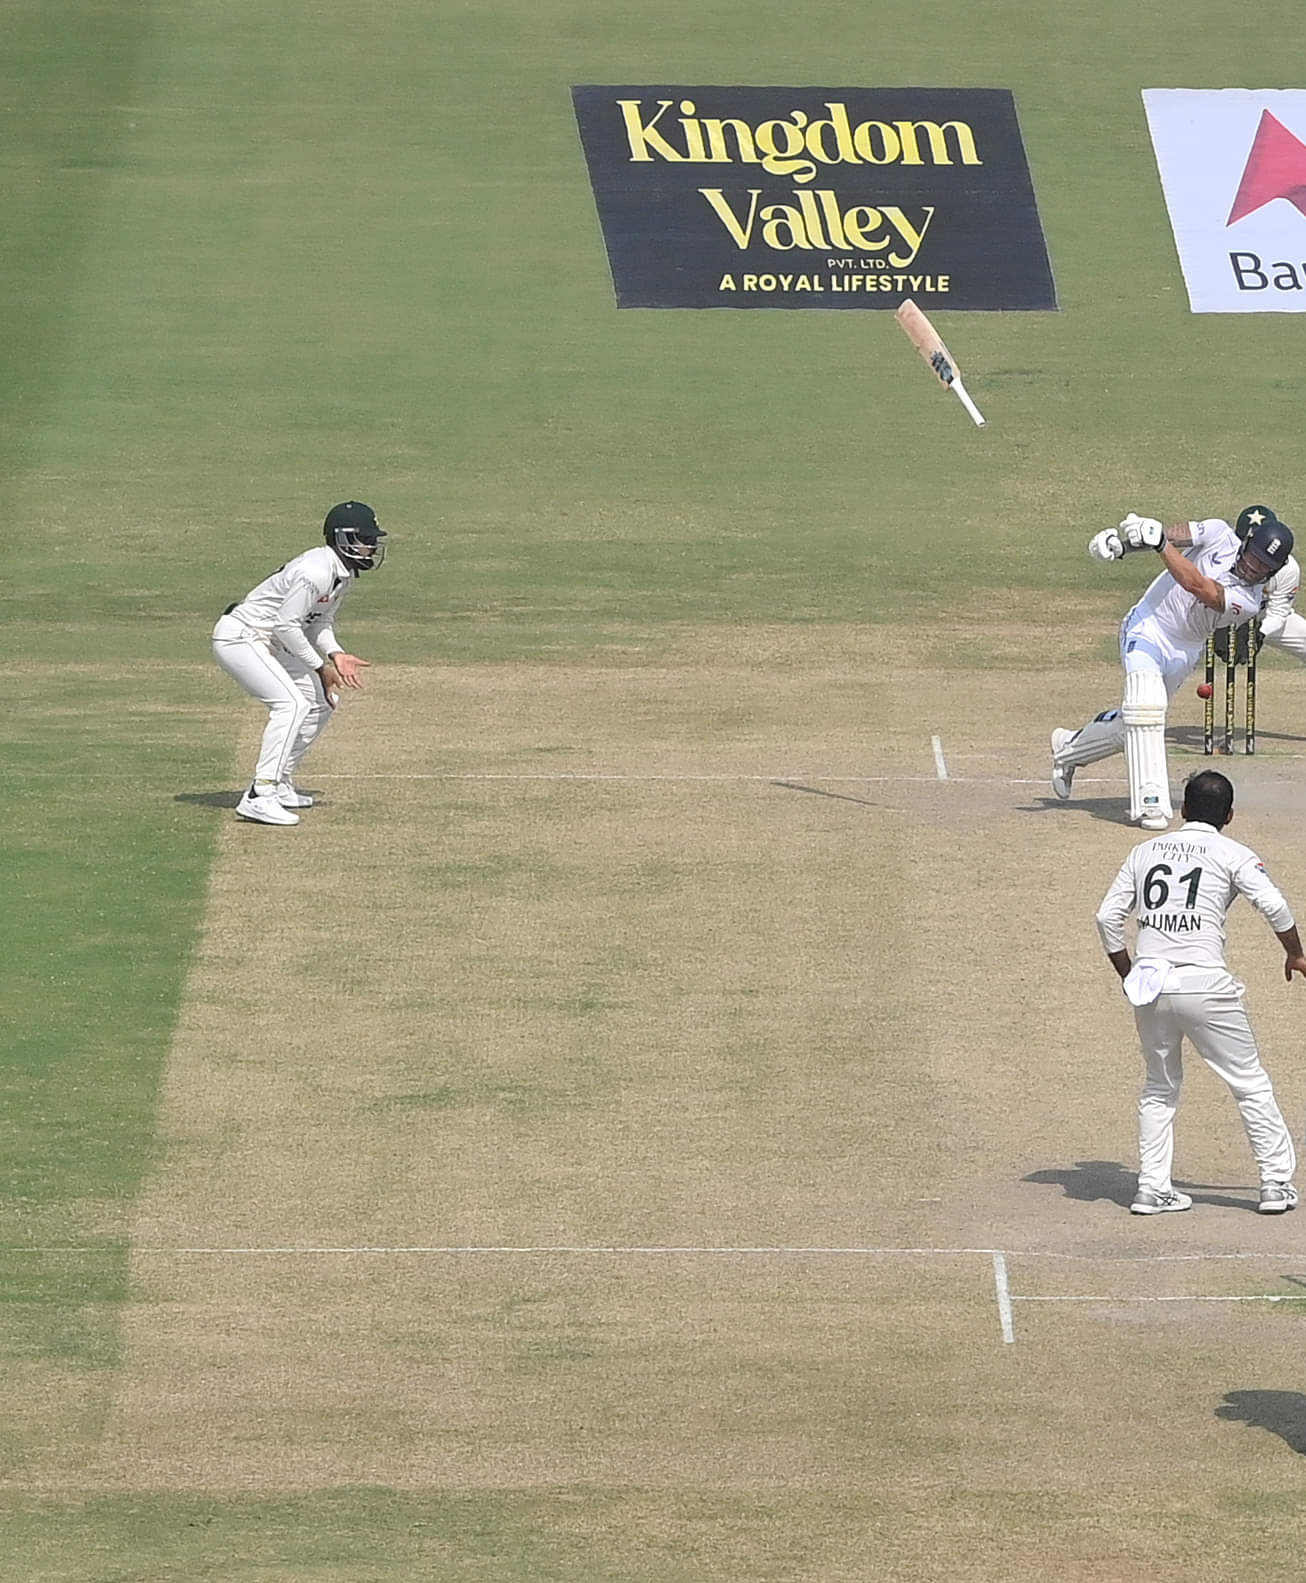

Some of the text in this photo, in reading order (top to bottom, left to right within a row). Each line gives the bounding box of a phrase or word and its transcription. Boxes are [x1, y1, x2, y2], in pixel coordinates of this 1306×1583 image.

[616, 99, 983, 183] Kingdom
[698, 188, 935, 268] Valley
[719, 274, 950, 292] A ROYAL LIFESTYLE
[827, 258, 889, 269] PVT. LTD.
[1143, 863, 1203, 910] 61
